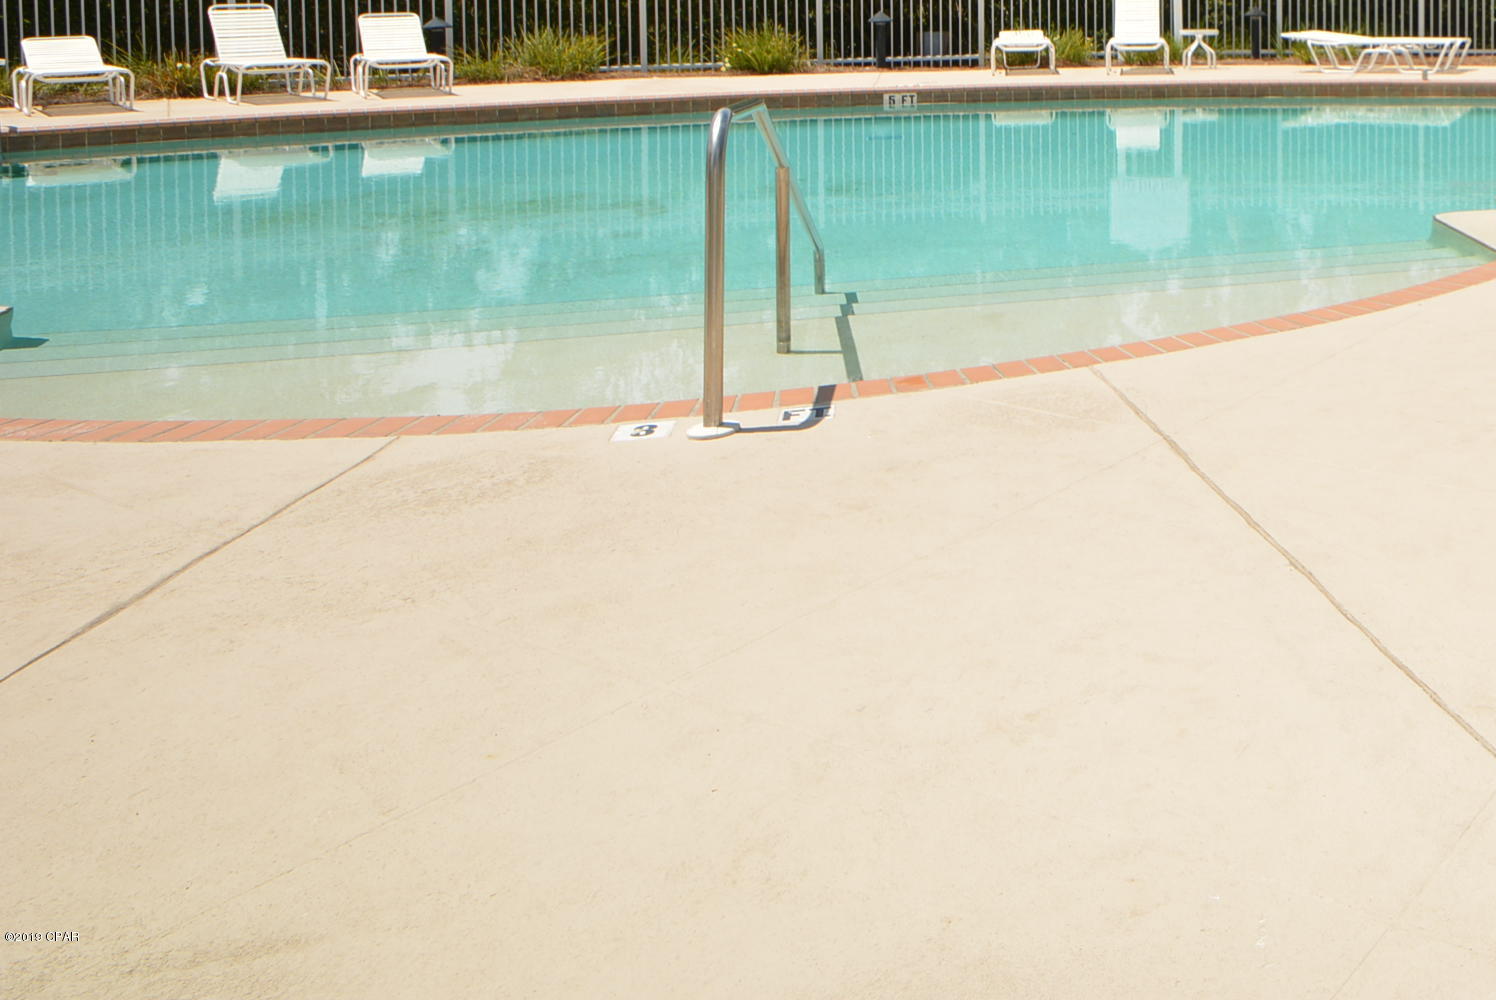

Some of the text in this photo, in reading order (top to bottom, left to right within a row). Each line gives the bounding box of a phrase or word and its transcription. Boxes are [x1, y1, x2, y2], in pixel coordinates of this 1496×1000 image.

[901, 94, 916, 106] FT
[629, 406, 831, 437] 3 FT
